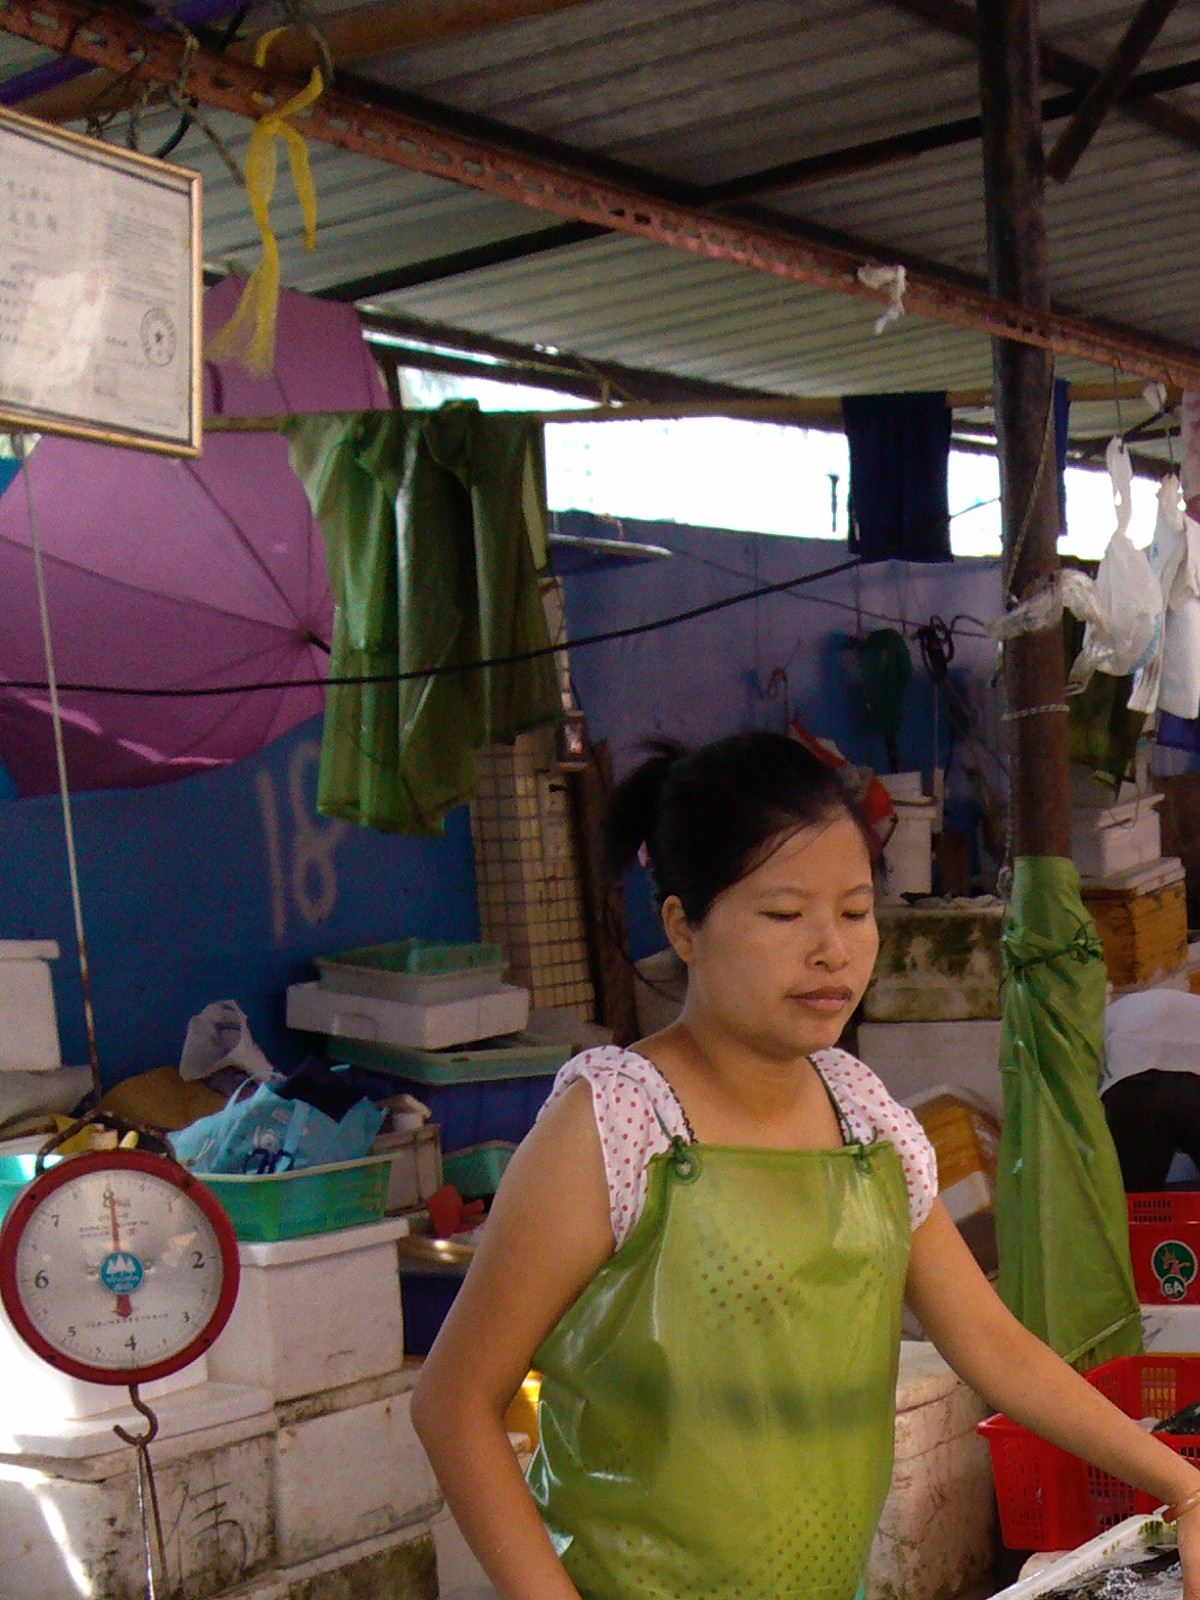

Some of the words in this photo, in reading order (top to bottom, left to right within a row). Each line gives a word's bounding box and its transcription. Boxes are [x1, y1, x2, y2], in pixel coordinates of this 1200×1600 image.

[103, 1191, 114, 1208] 8
[51, 1214, 60, 1228] 7
[191, 1251, 205, 1269] 2
[35, 1270, 49, 1289] 6
[182, 1311, 190, 1322] 3
[67, 1326, 76, 1337] 5
[124, 1332, 137, 1351] 4
